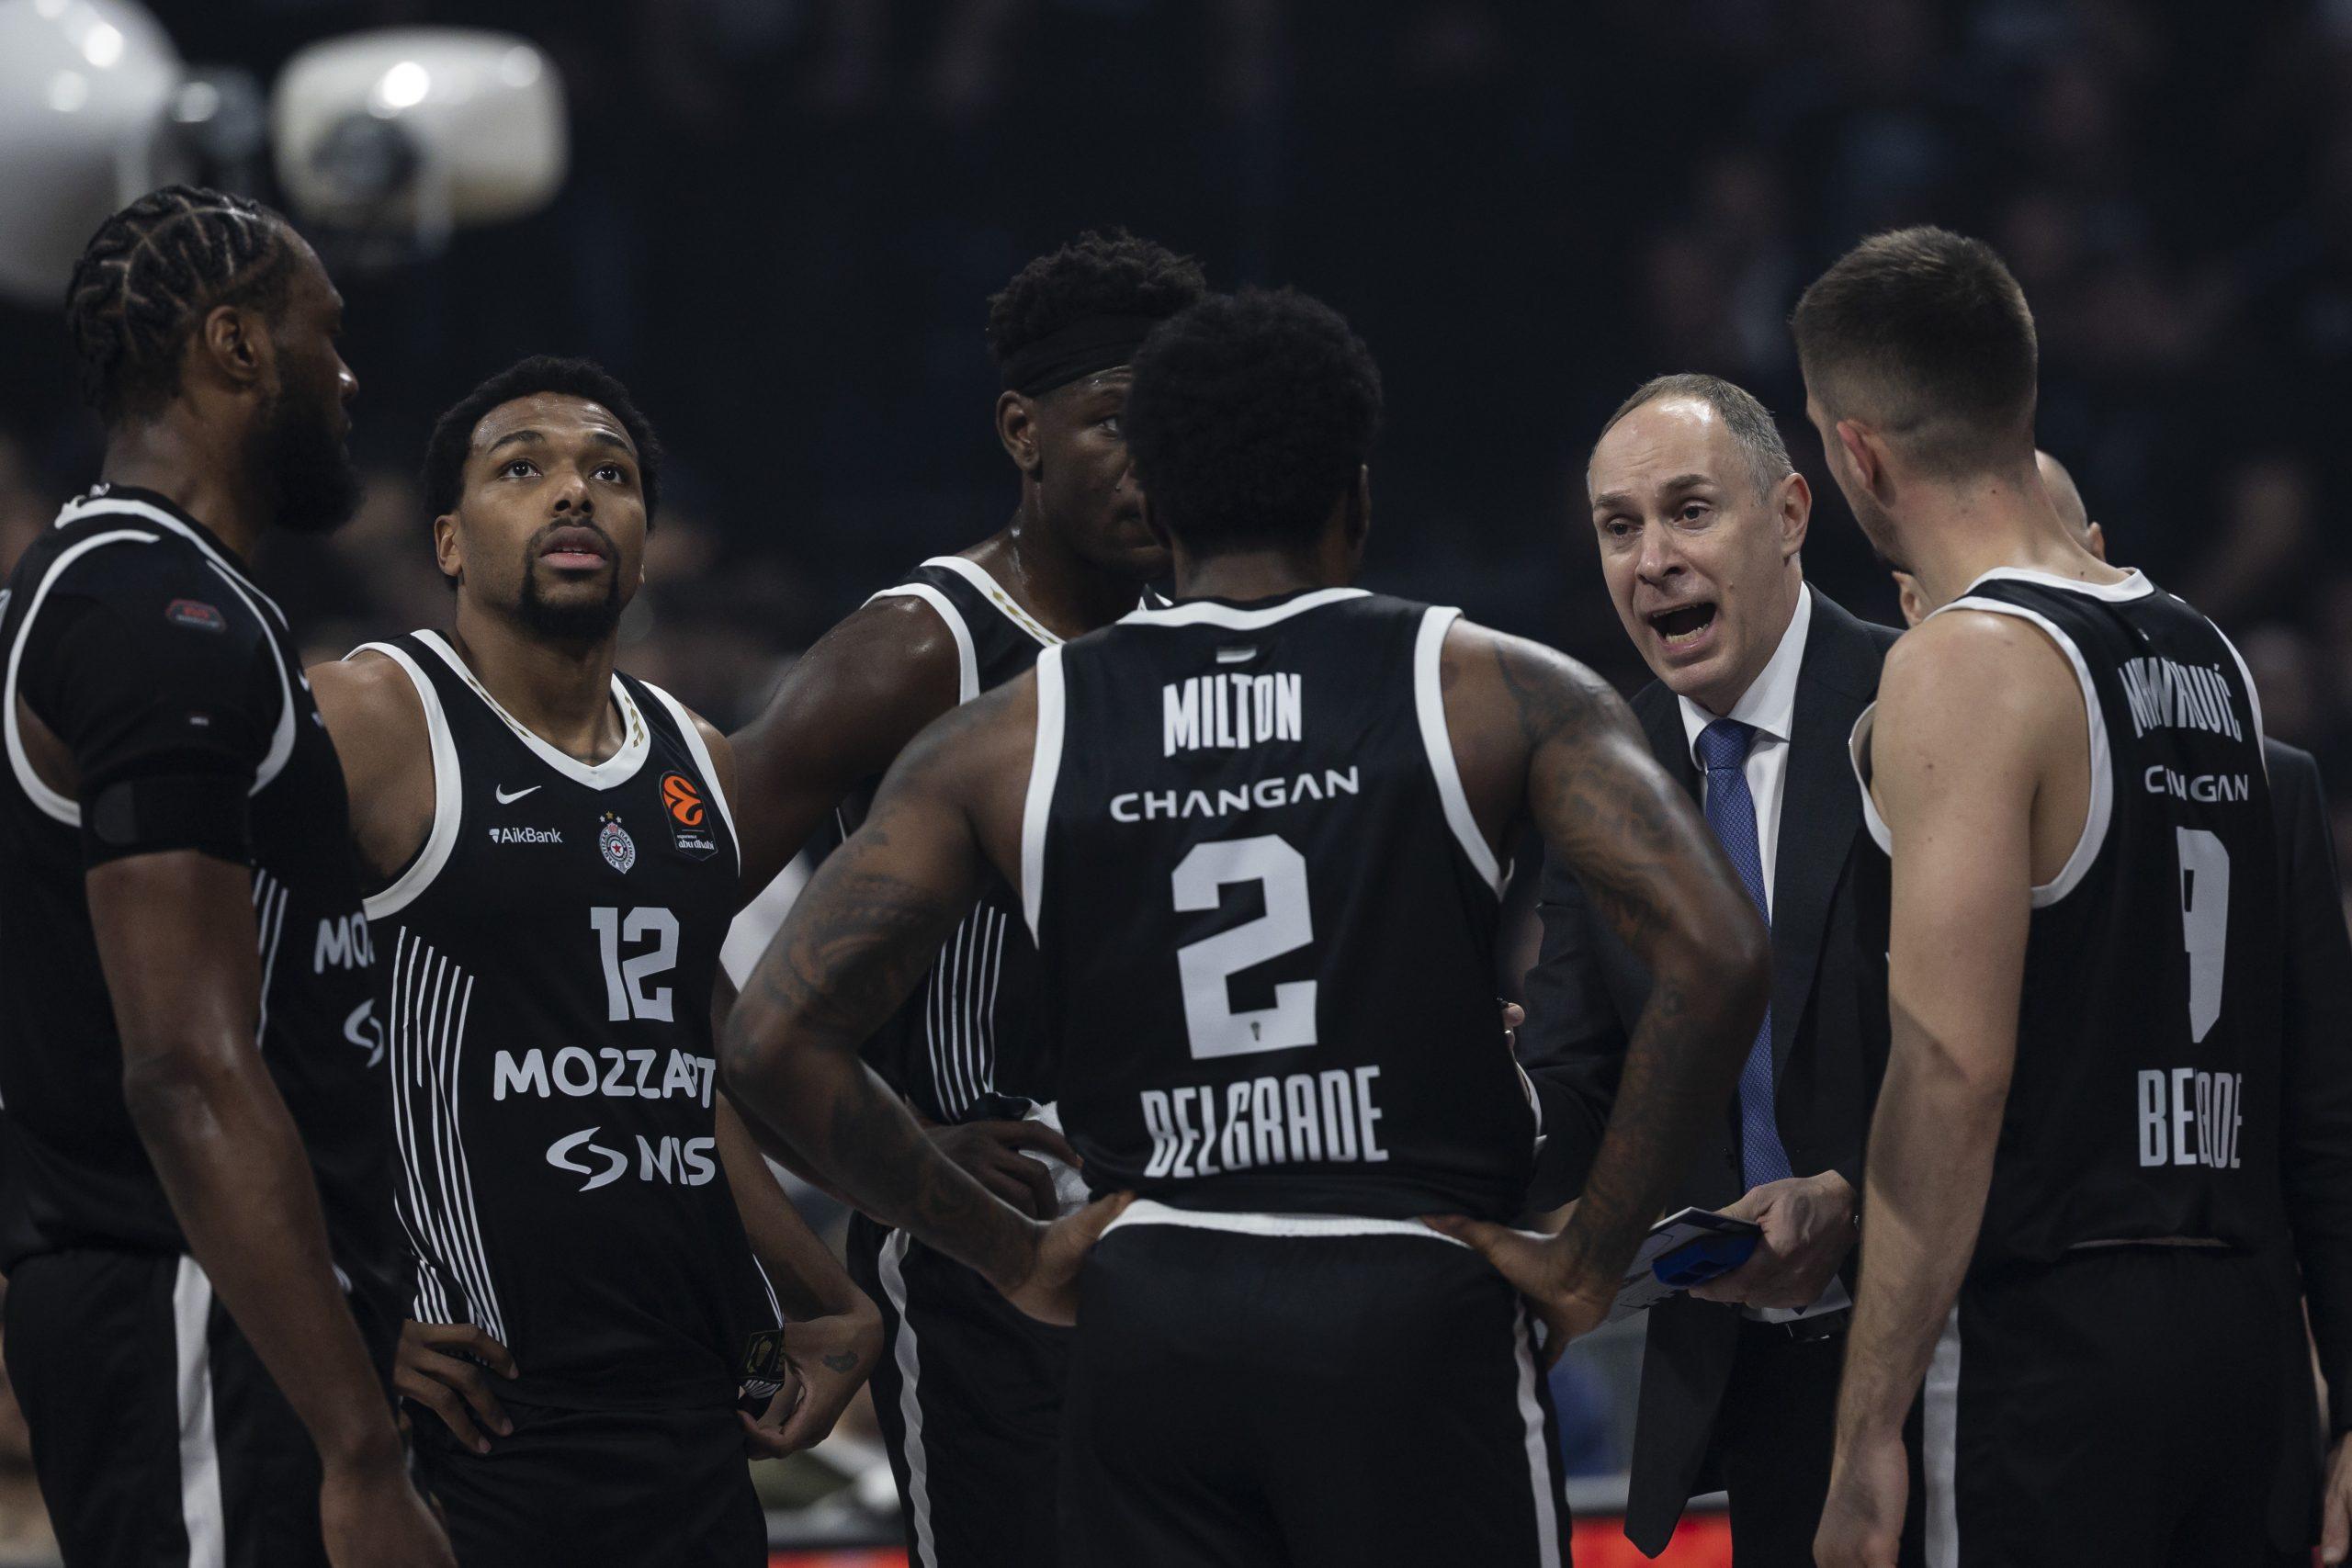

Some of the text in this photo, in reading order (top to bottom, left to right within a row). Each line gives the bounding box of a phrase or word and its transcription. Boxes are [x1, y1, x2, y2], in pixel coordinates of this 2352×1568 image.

[1163, 672, 1302, 758] MILTON
[1110, 766, 1360, 822] CHANGAN
[501, 827, 563, 843] AikBank
[678, 839, 715, 851] abu dhabi
[590, 907, 680, 1022] 12
[1171, 834, 1318, 1059] 2
[493, 1046, 717, 1109] MOZZART
[1140, 1066, 1388, 1179] BELGRADE
[635, 1134, 716, 1186] NIS
